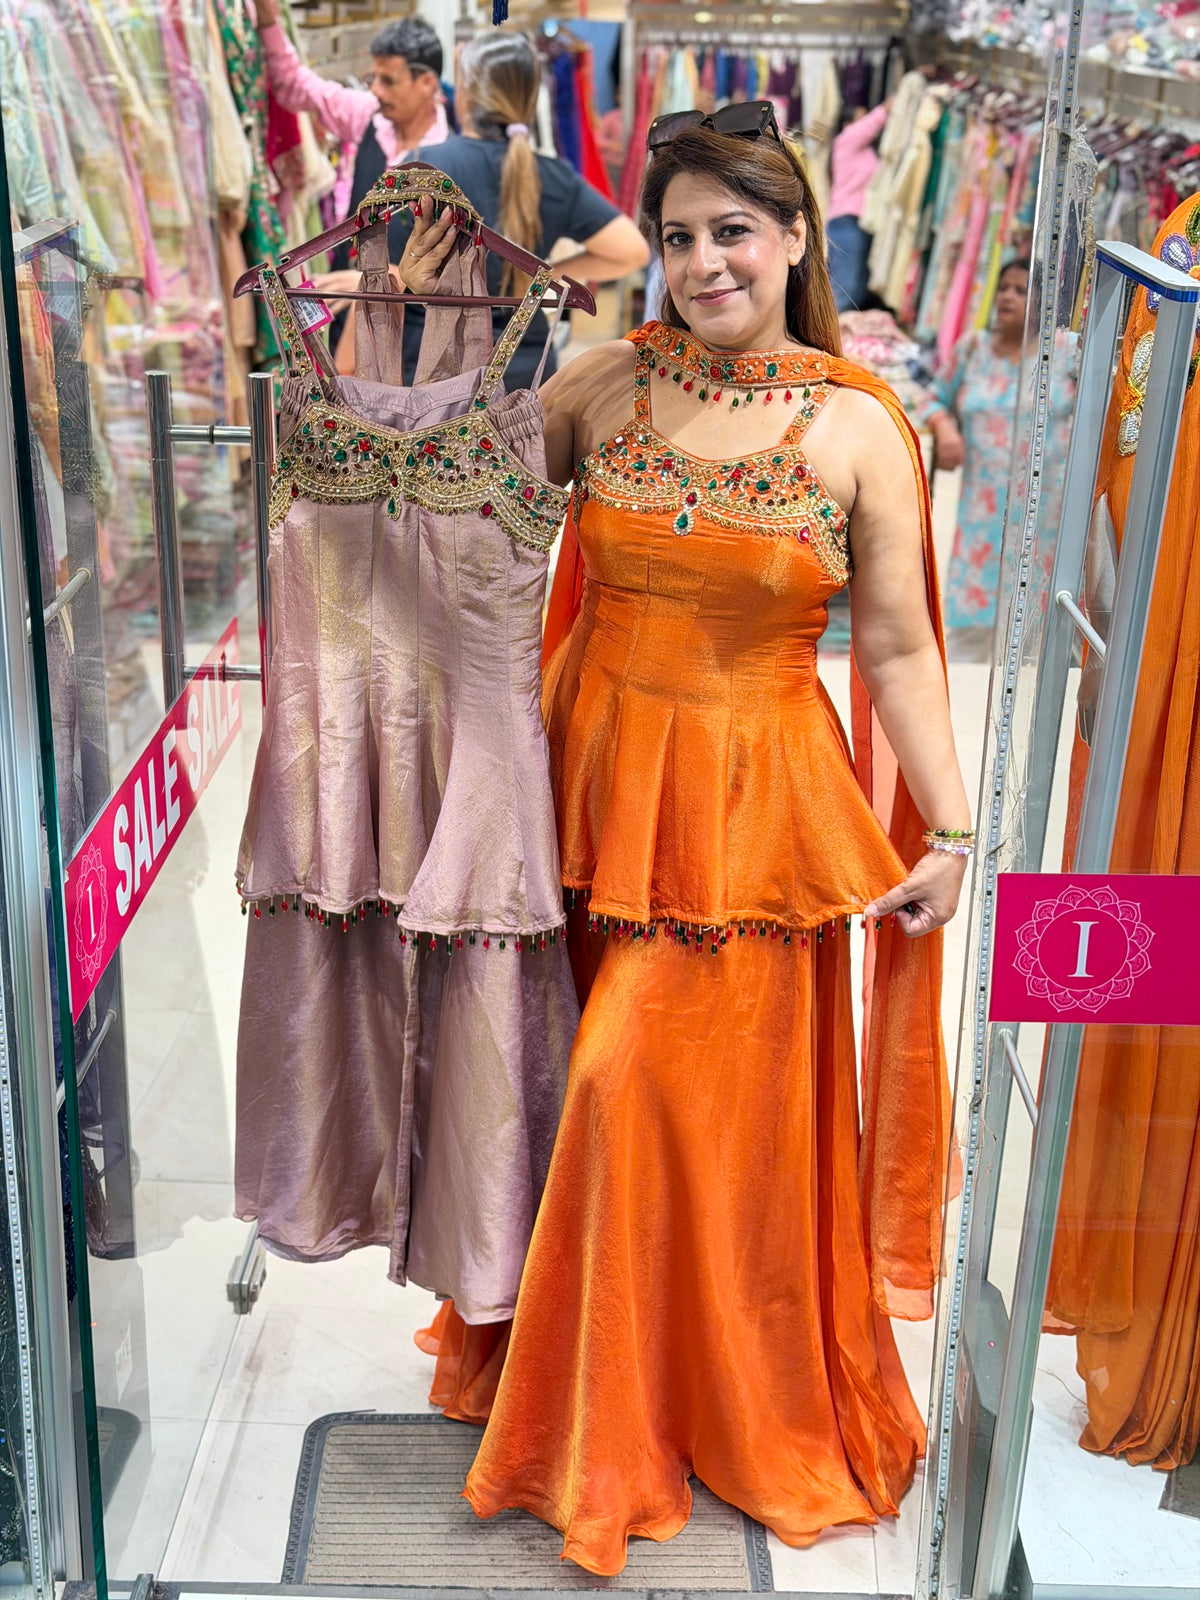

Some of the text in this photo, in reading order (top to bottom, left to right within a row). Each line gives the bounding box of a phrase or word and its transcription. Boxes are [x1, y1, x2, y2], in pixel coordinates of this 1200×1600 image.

[113, 724, 181, 917] SALE
[187, 634, 239, 793] SALE
[1067, 921, 1099, 978] I
